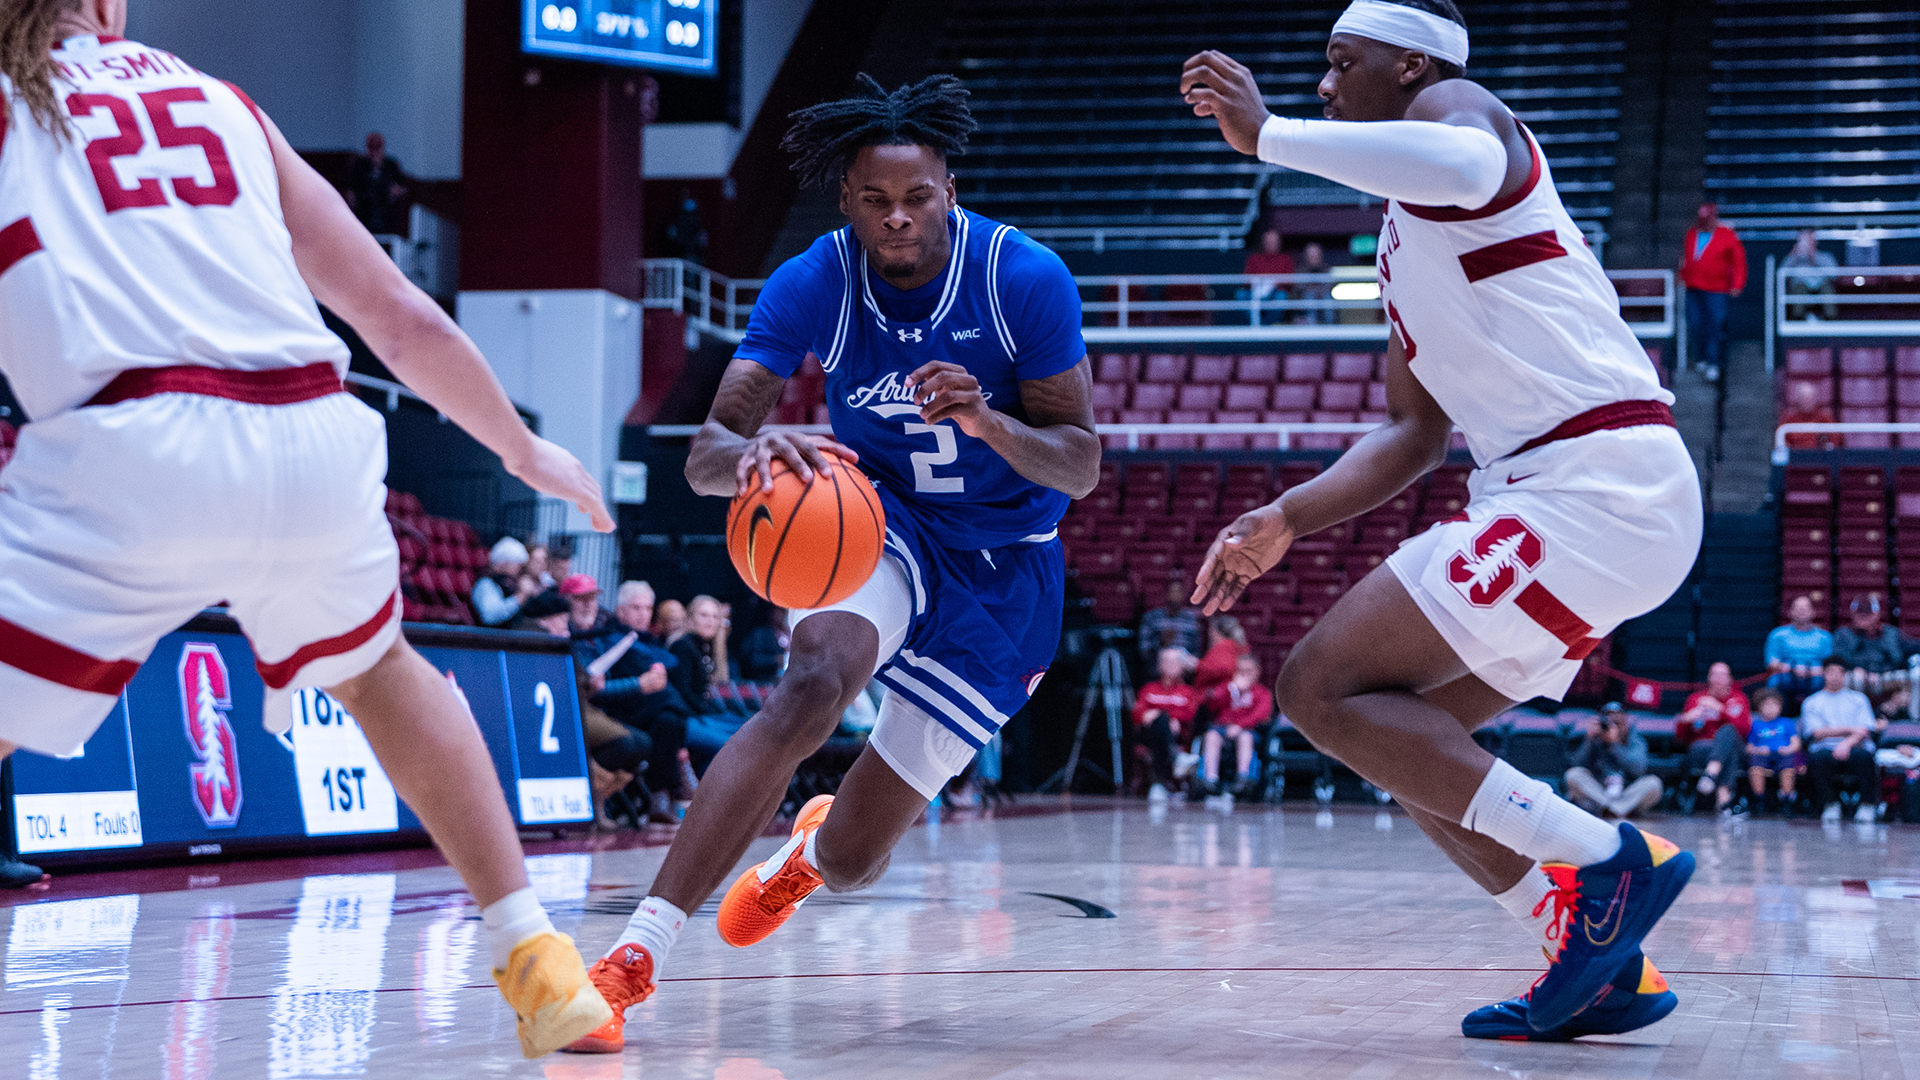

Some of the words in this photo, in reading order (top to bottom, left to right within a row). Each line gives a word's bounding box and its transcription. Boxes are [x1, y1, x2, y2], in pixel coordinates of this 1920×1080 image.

[65, 86, 240, 213] 25
[951, 328, 981, 341] WAC
[904, 421, 965, 493] 2
[533, 680, 561, 754] 2
[322, 767, 366, 812] 1ST
[25, 814, 56, 840] TOL
[59, 813, 68, 838] 4
[94, 809, 129, 836] Fouls
